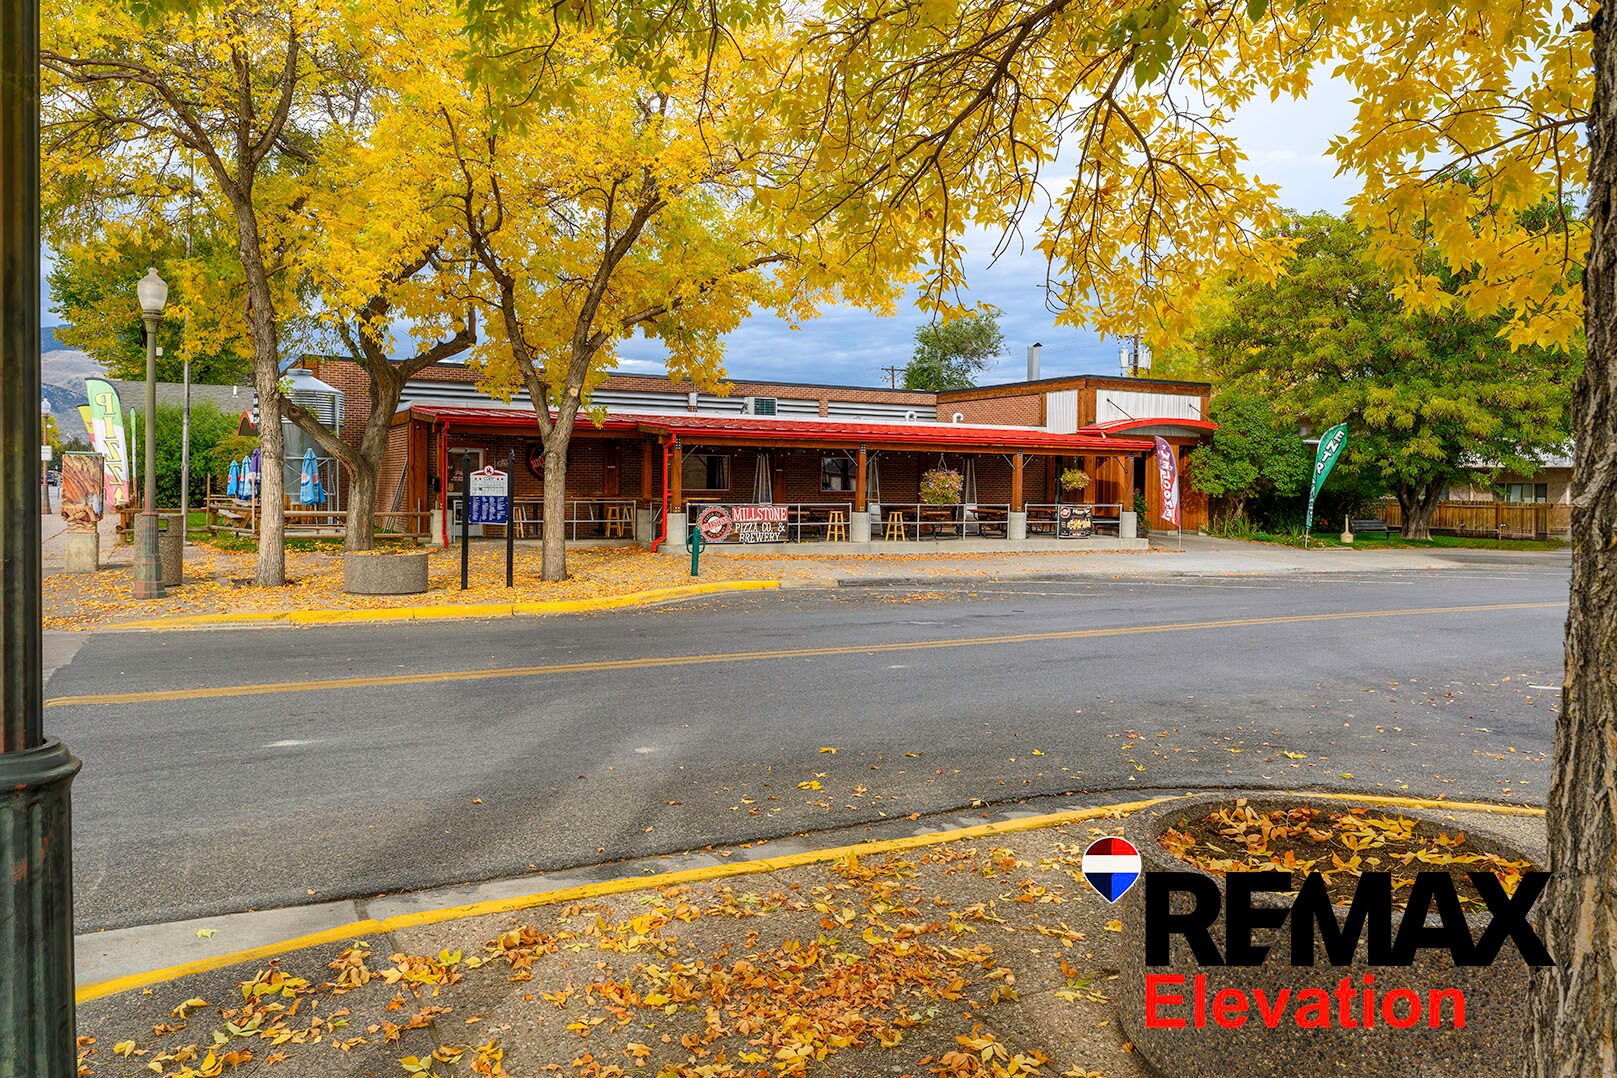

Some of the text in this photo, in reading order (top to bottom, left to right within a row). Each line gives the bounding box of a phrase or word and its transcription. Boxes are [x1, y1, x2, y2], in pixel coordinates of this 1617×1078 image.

[733, 507, 787, 521] MILLSTONE
[734, 522, 758, 534] PIZZA
[777, 522, 786, 533] &
[739, 533, 781, 543] BREWERY
